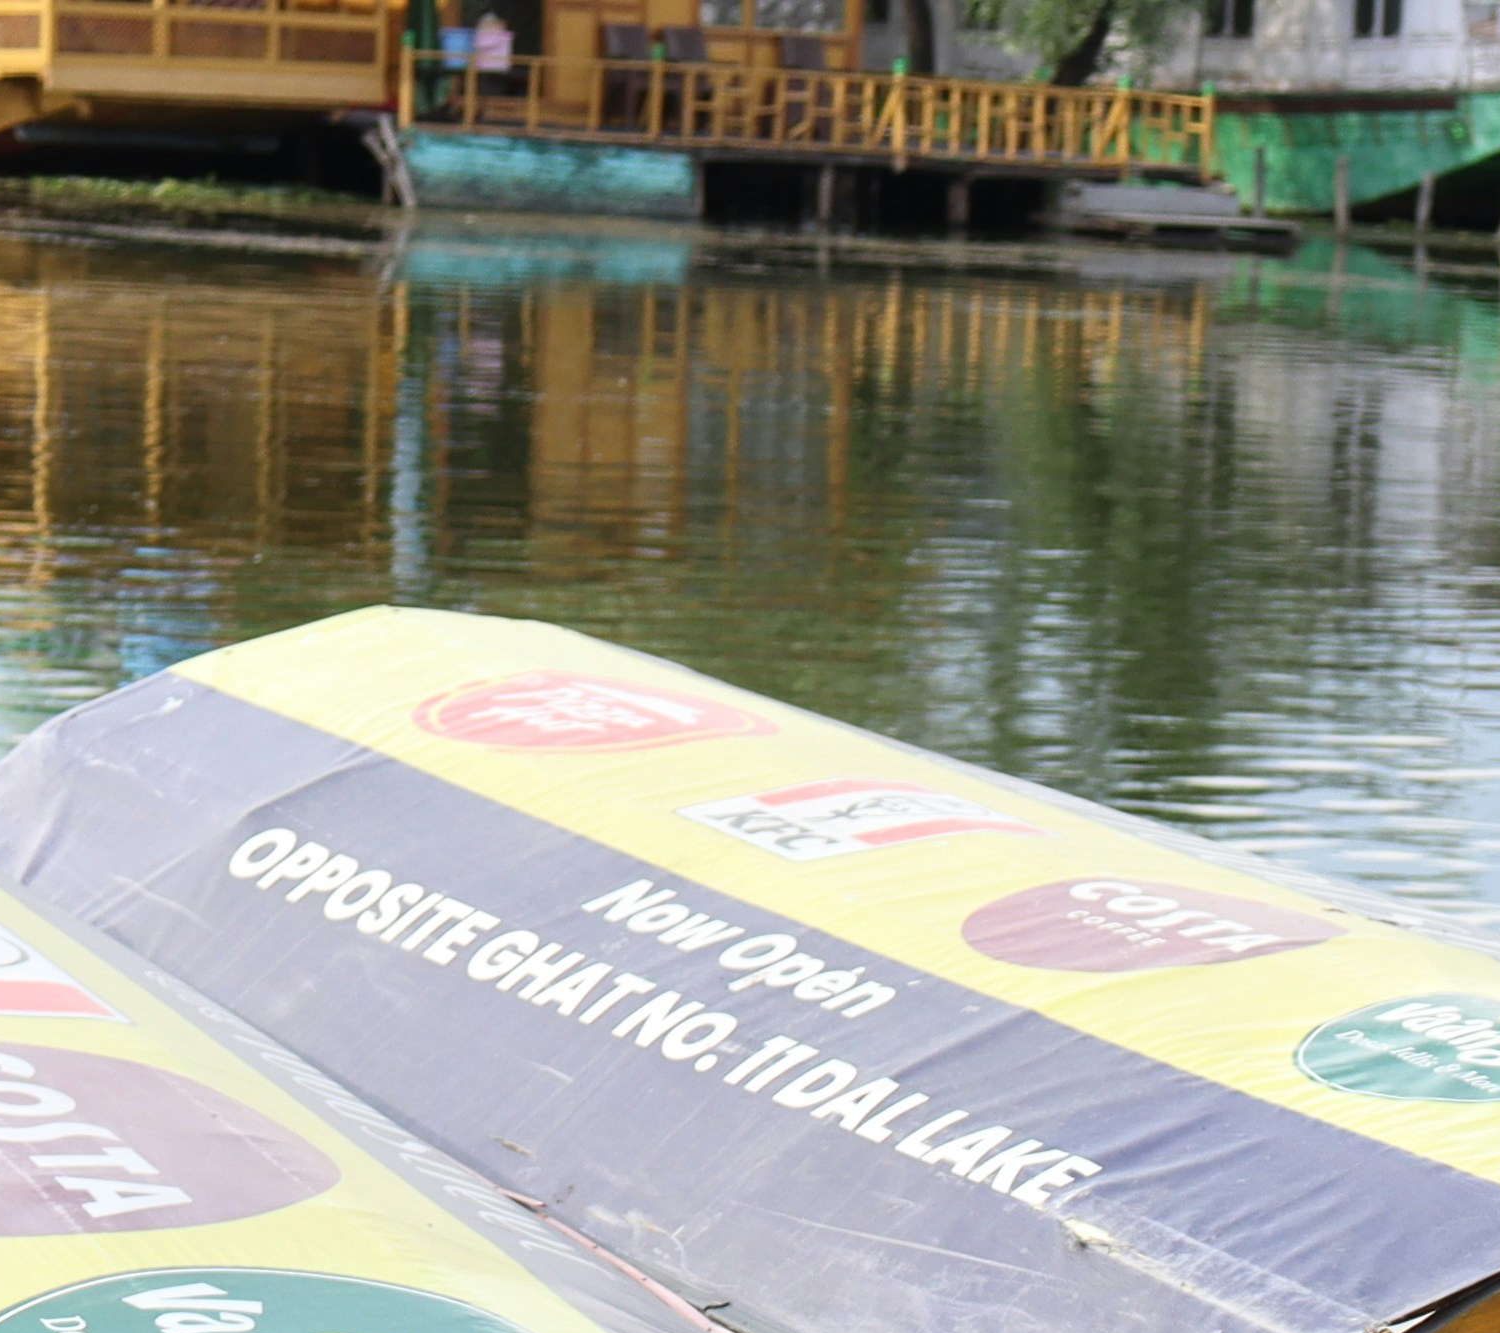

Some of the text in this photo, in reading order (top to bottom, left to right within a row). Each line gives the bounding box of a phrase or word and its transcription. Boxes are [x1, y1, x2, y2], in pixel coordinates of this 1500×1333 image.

[706, 809, 841, 852] KFC
[581, 878, 897, 1019] Now Open
[1066, 910, 1167, 947] COFFEE
[1069, 881, 1283, 953] COSTA
[228, 827, 1102, 1204] OPPOSITE GHAT NO. 11 DAL LAKE
